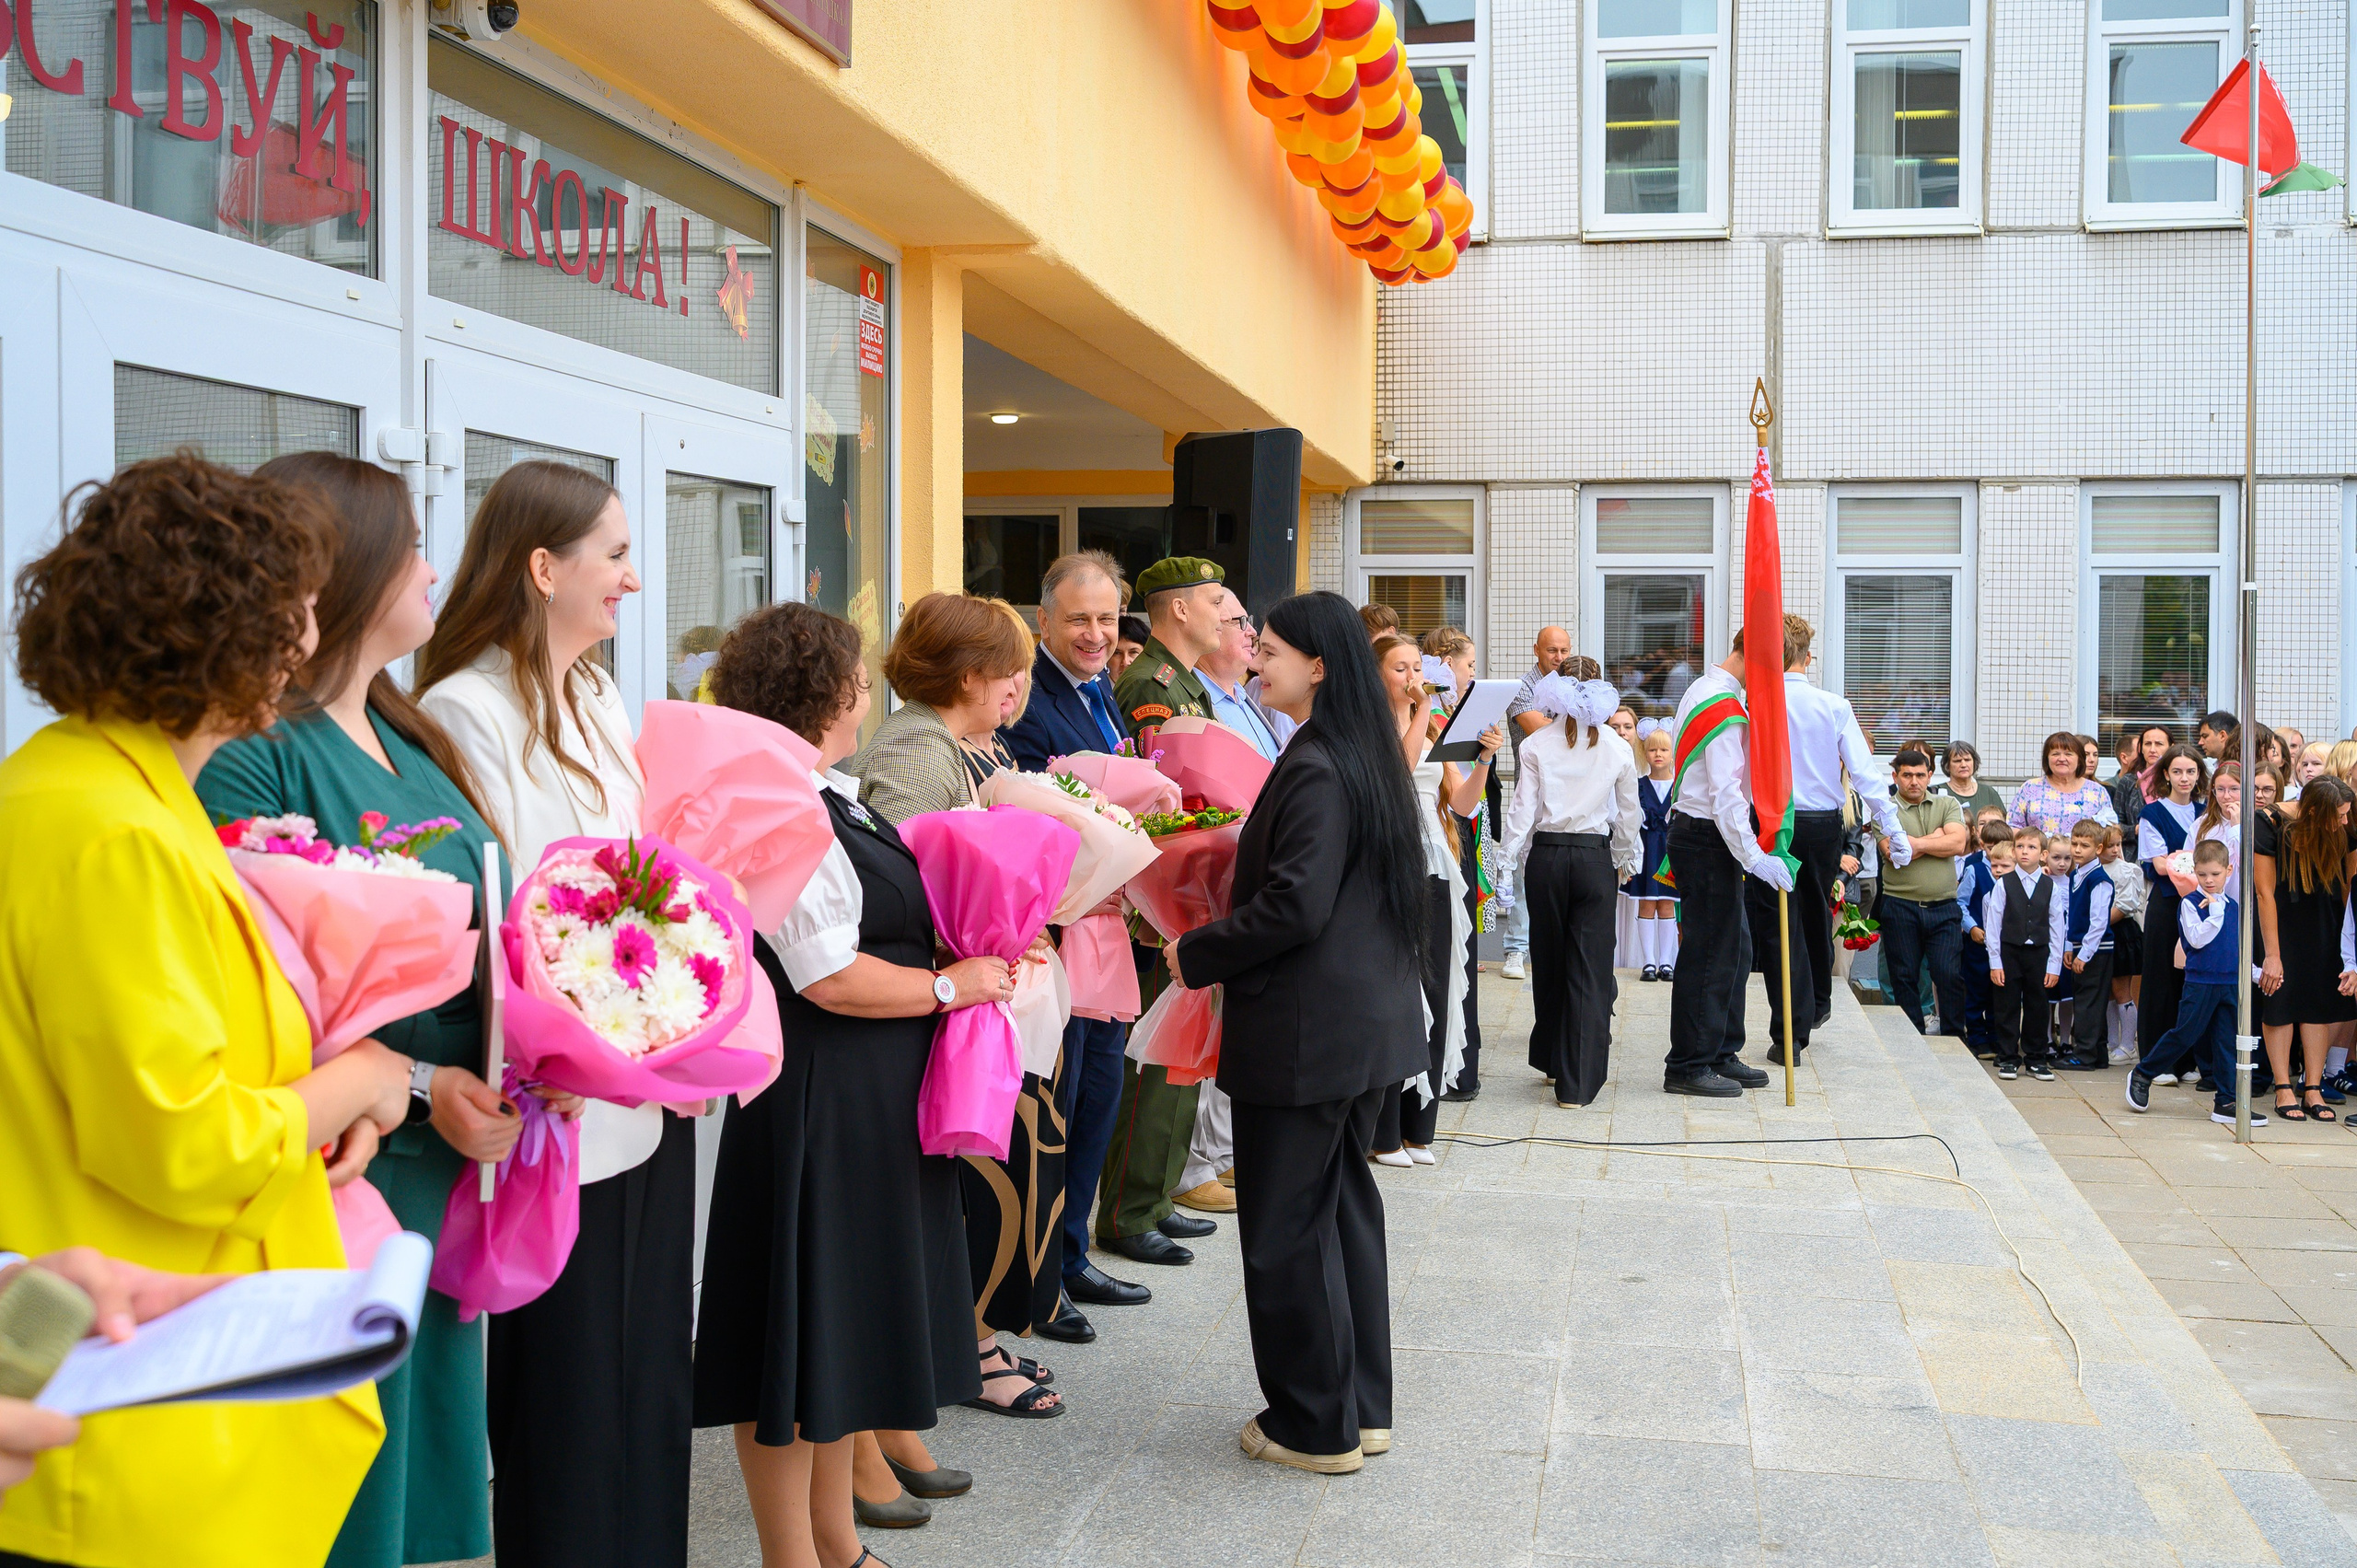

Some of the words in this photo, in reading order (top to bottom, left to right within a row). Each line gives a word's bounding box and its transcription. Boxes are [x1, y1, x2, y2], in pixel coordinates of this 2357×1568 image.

[0, 0, 370, 228] СТВУЙ,
[438, 114, 690, 318] ШКОЛА!
[861, 321, 883, 344] ЗДЕСЬ
[1137, 706, 1168, 716] СПЕЦНАЗ
